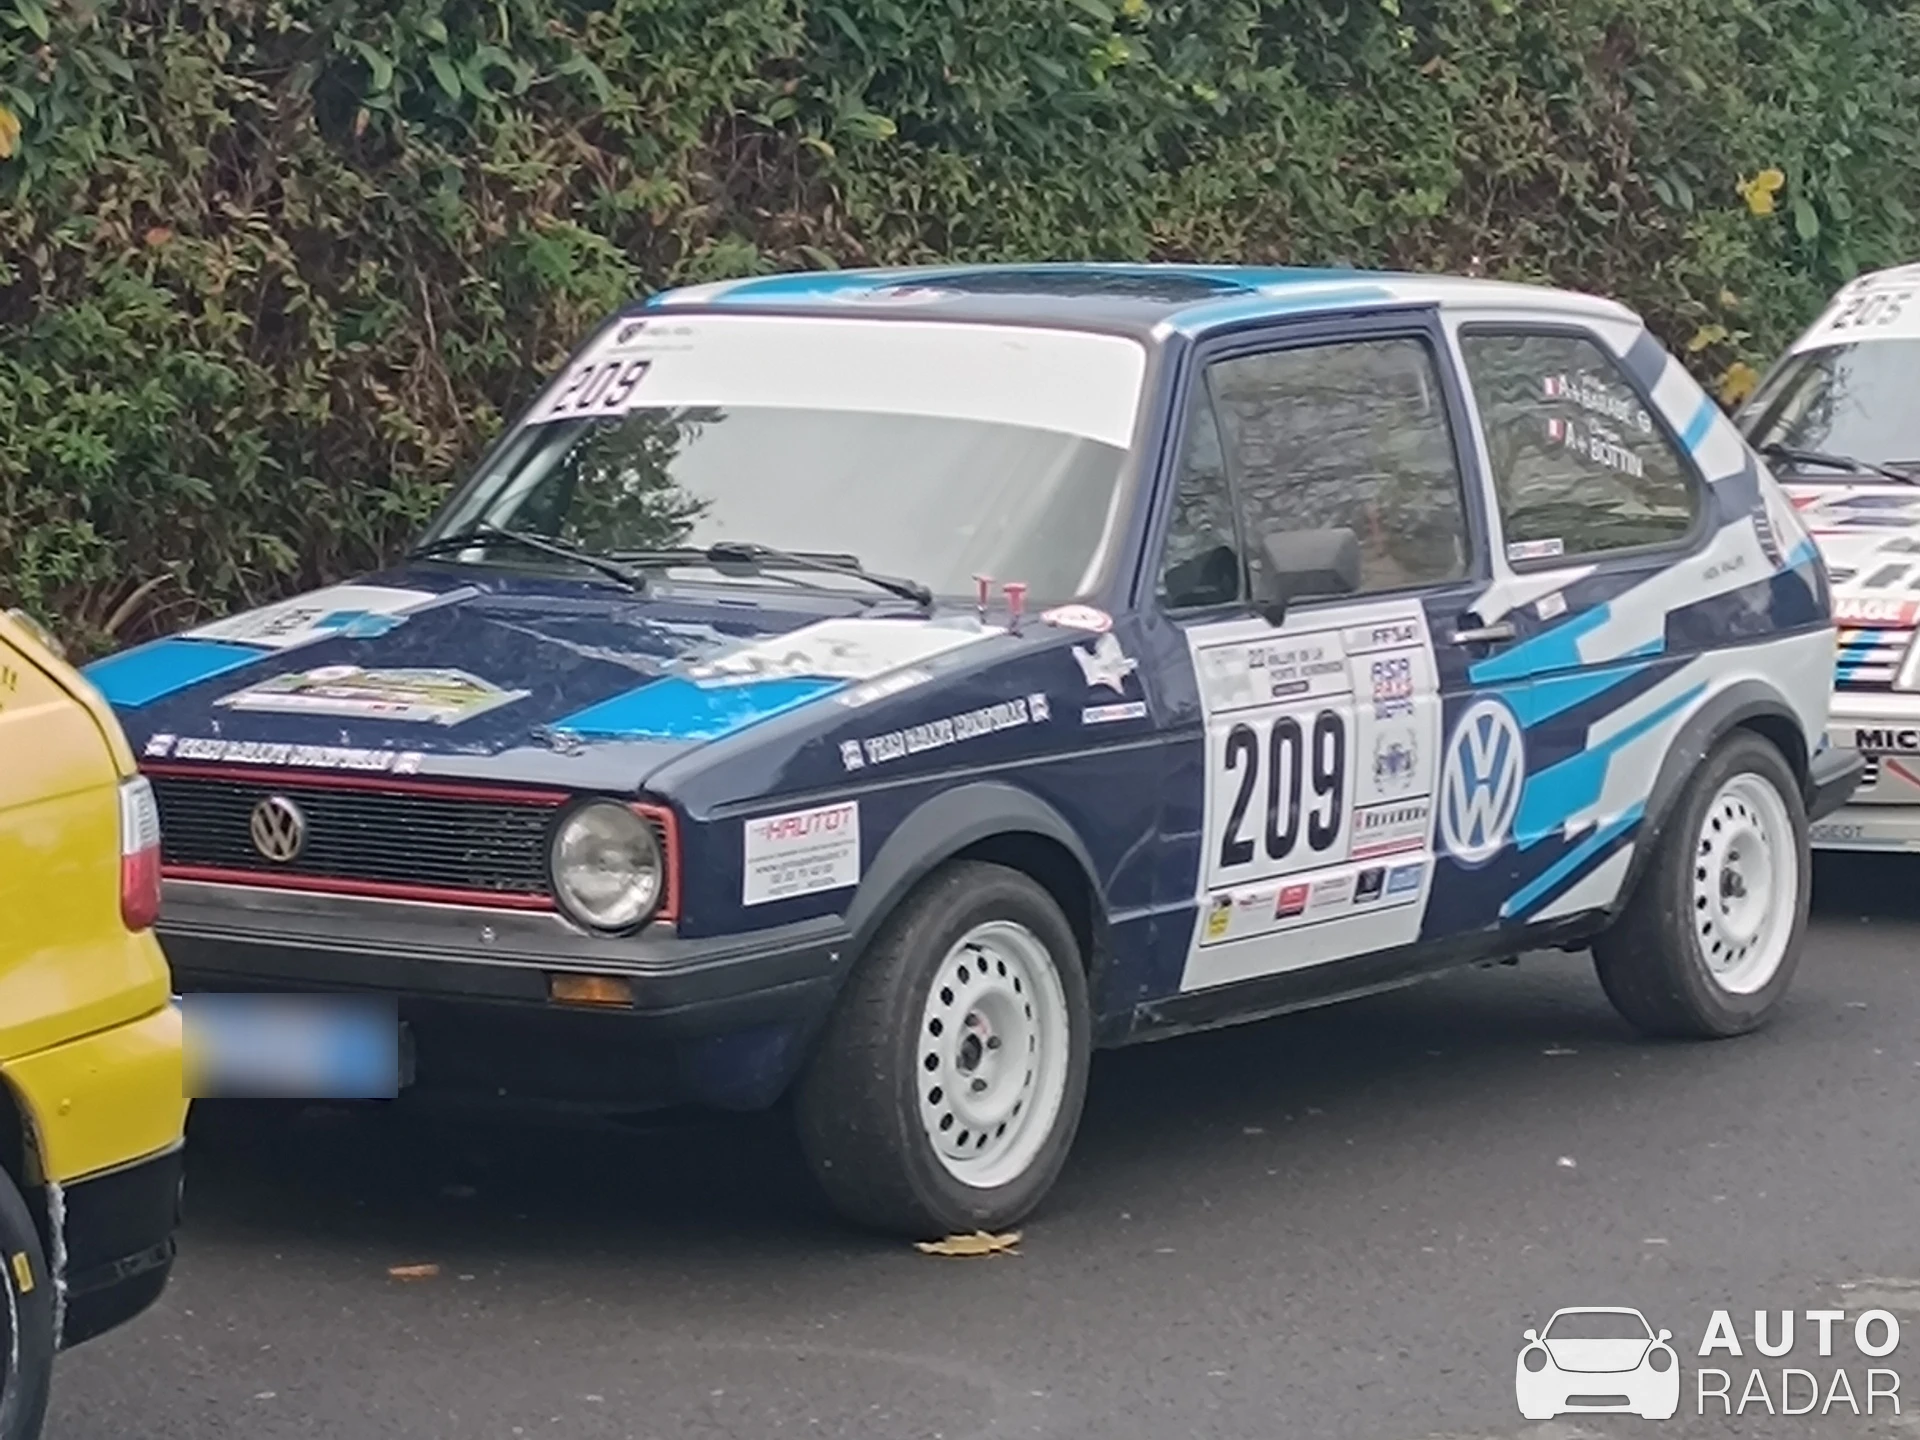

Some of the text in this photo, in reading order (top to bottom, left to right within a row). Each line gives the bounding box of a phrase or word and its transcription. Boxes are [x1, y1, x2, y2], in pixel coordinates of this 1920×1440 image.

[1830, 294, 1911, 330] 205
[551, 359, 651, 413] 209
[1856, 729, 1918, 748] MIC
[1221, 709, 1345, 868] 209
